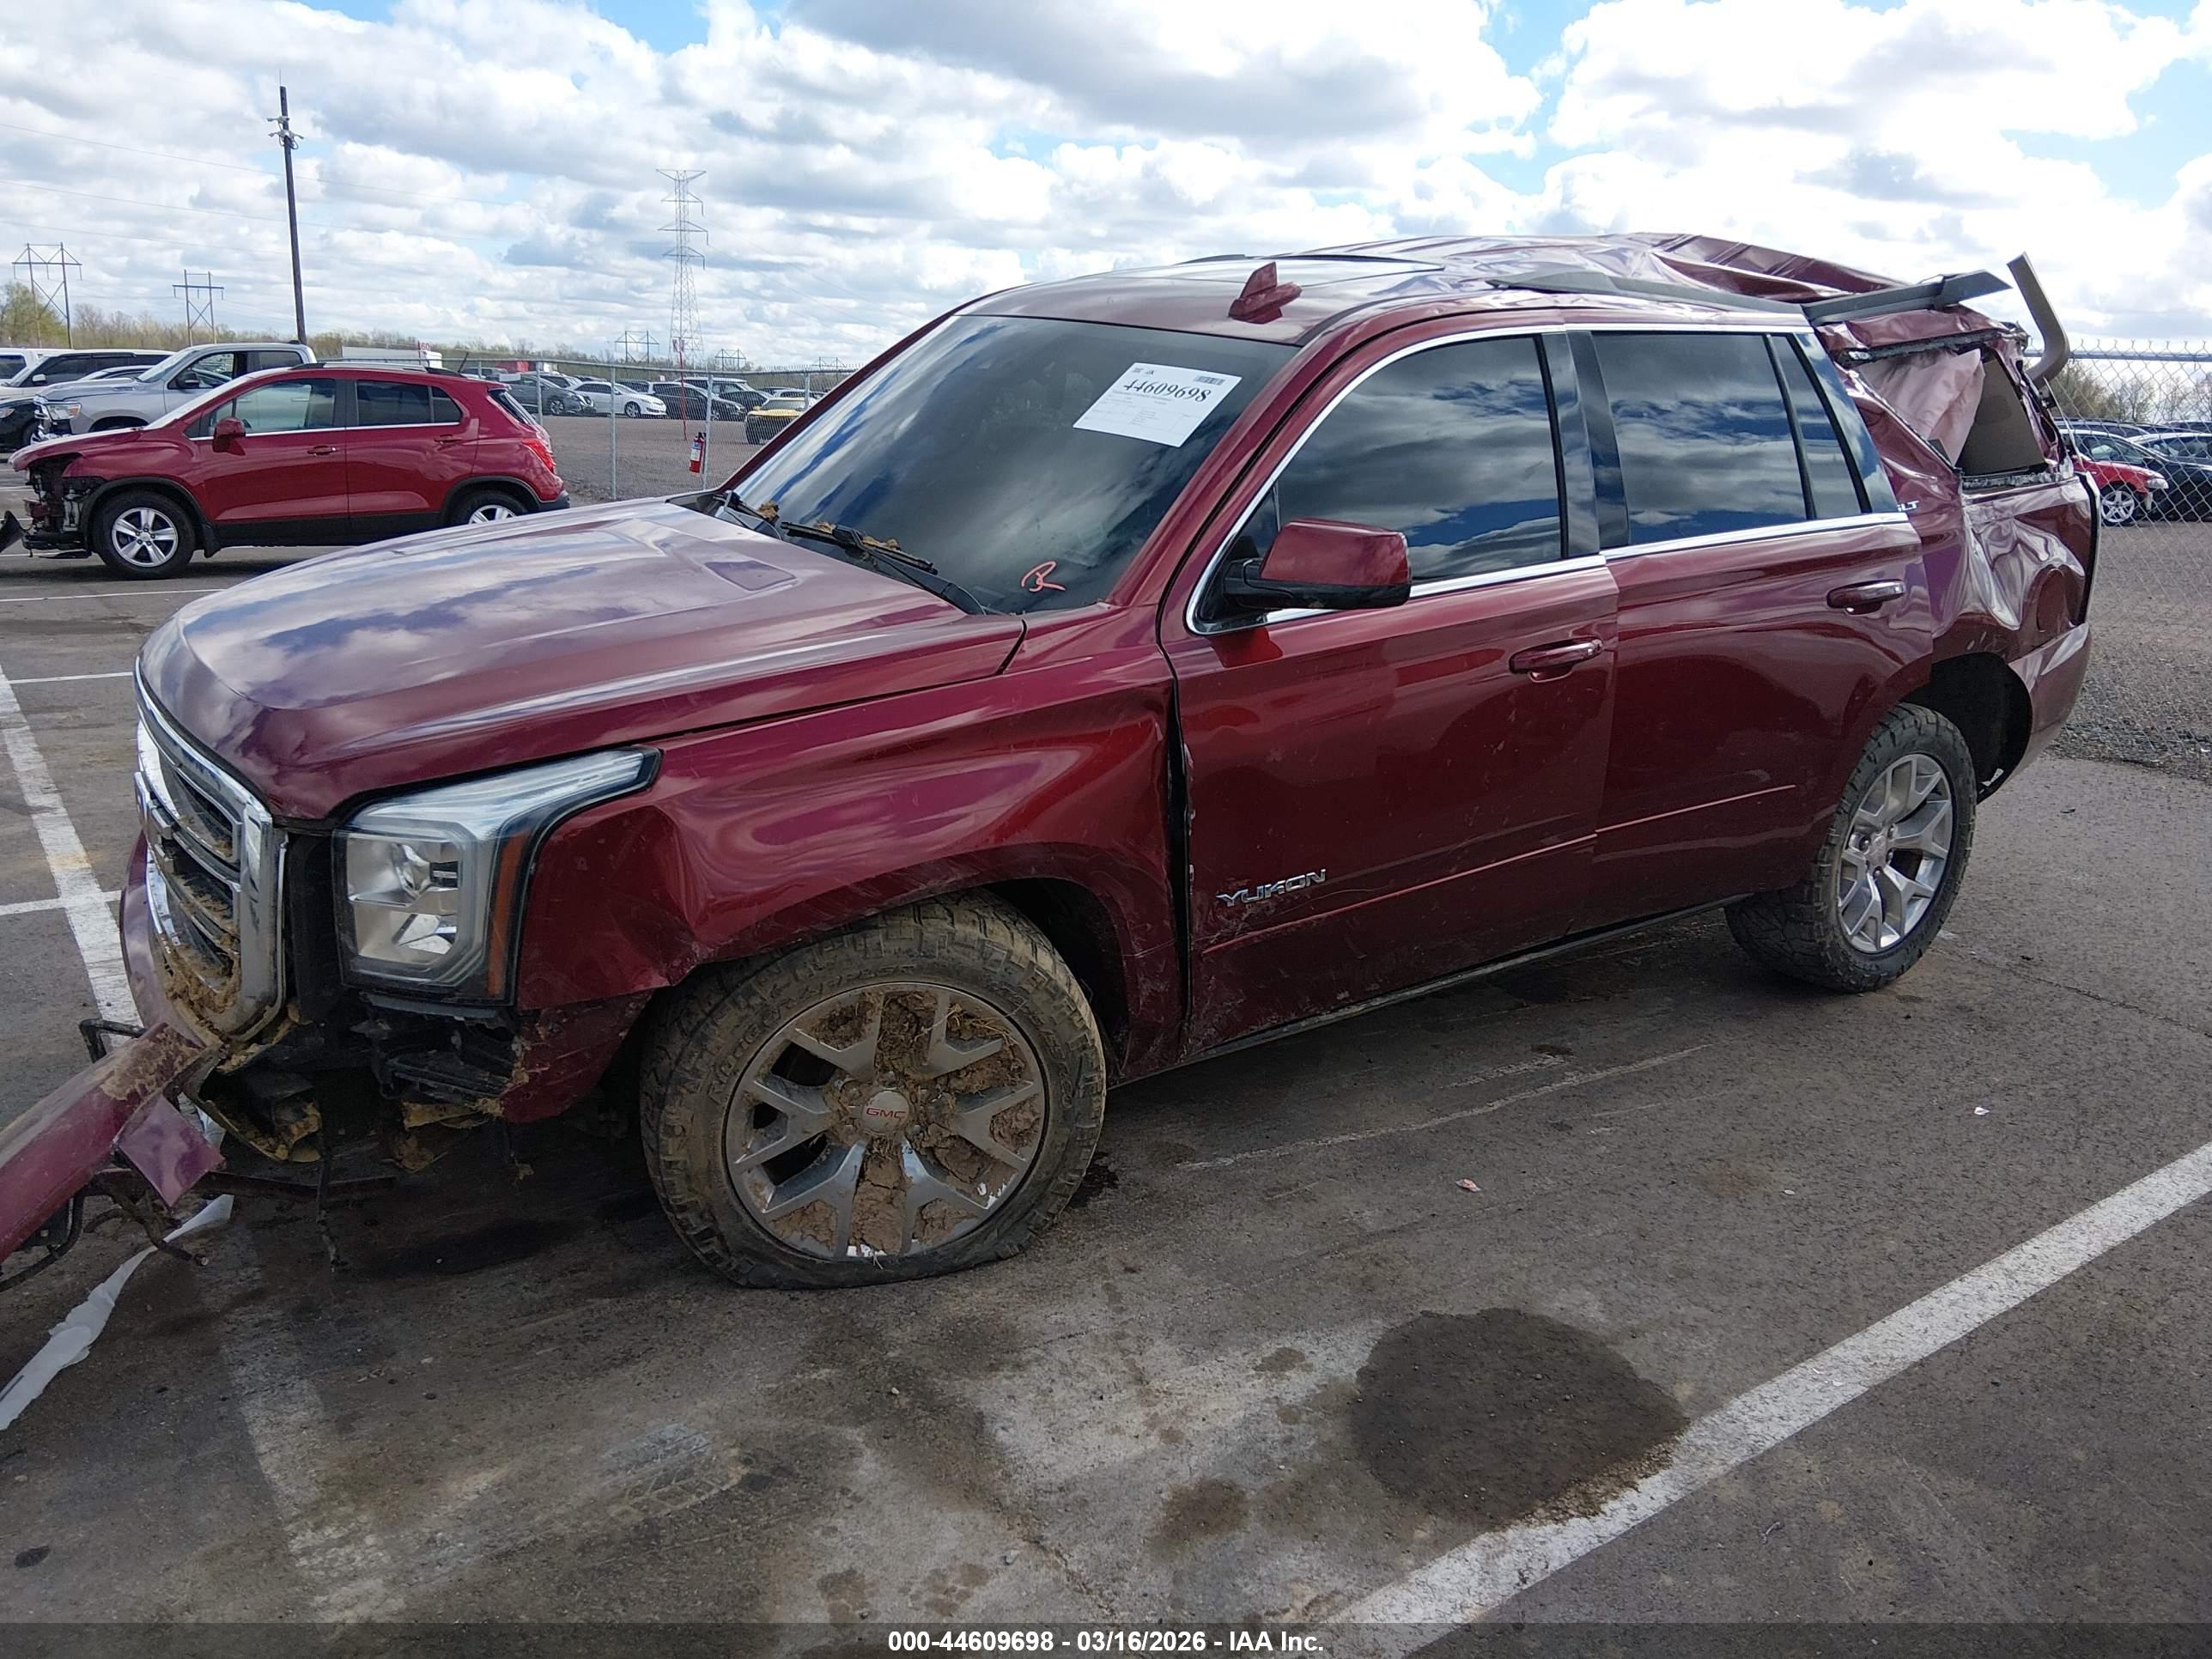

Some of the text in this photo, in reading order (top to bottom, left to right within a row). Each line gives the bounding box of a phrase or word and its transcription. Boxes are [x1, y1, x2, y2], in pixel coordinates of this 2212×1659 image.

[1123, 379, 1212, 403] 44609698
[1216, 868, 1327, 908] YUKON
[866, 1107, 907, 1119] GMC
